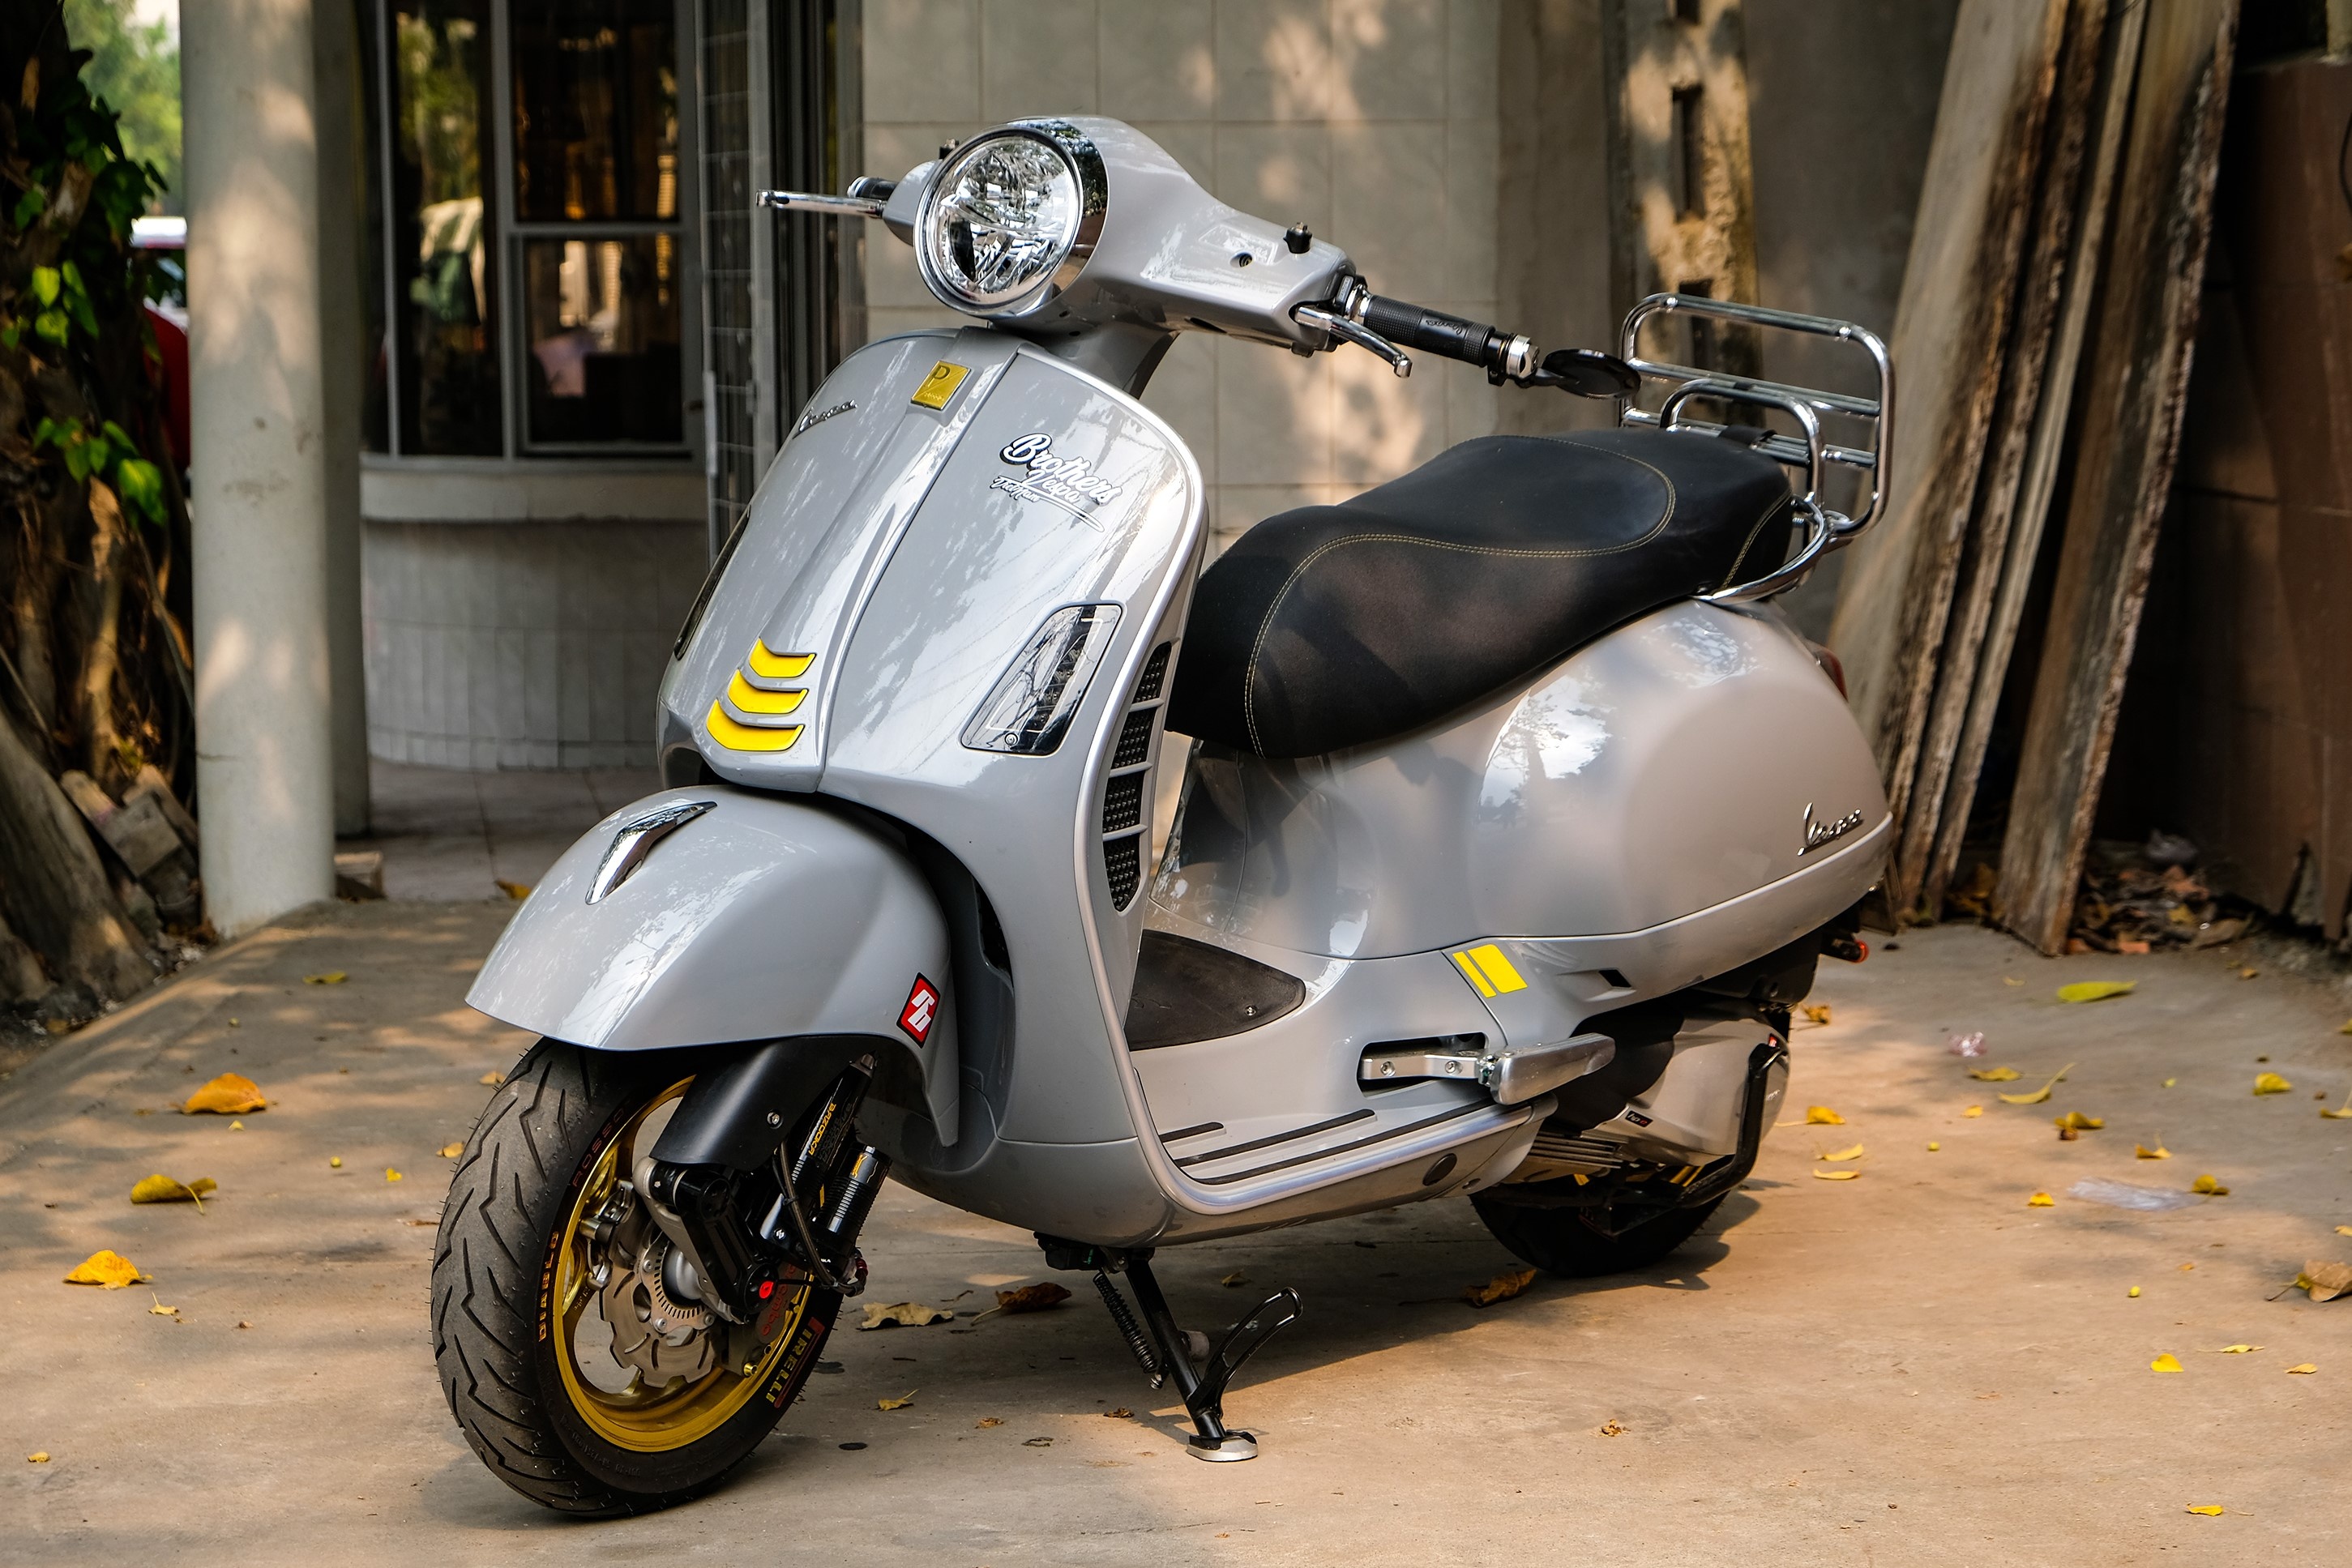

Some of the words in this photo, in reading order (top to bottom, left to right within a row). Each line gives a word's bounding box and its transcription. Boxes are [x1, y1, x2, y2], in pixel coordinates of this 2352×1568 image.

[999, 433, 1123, 506] Brothers
[1022, 469, 1080, 502] Vespa
[808, 1102, 837, 1156] BAZOOKA
[538, 1231, 559, 1343] DIABLO
[572, 1107, 624, 1187] ROSSO
